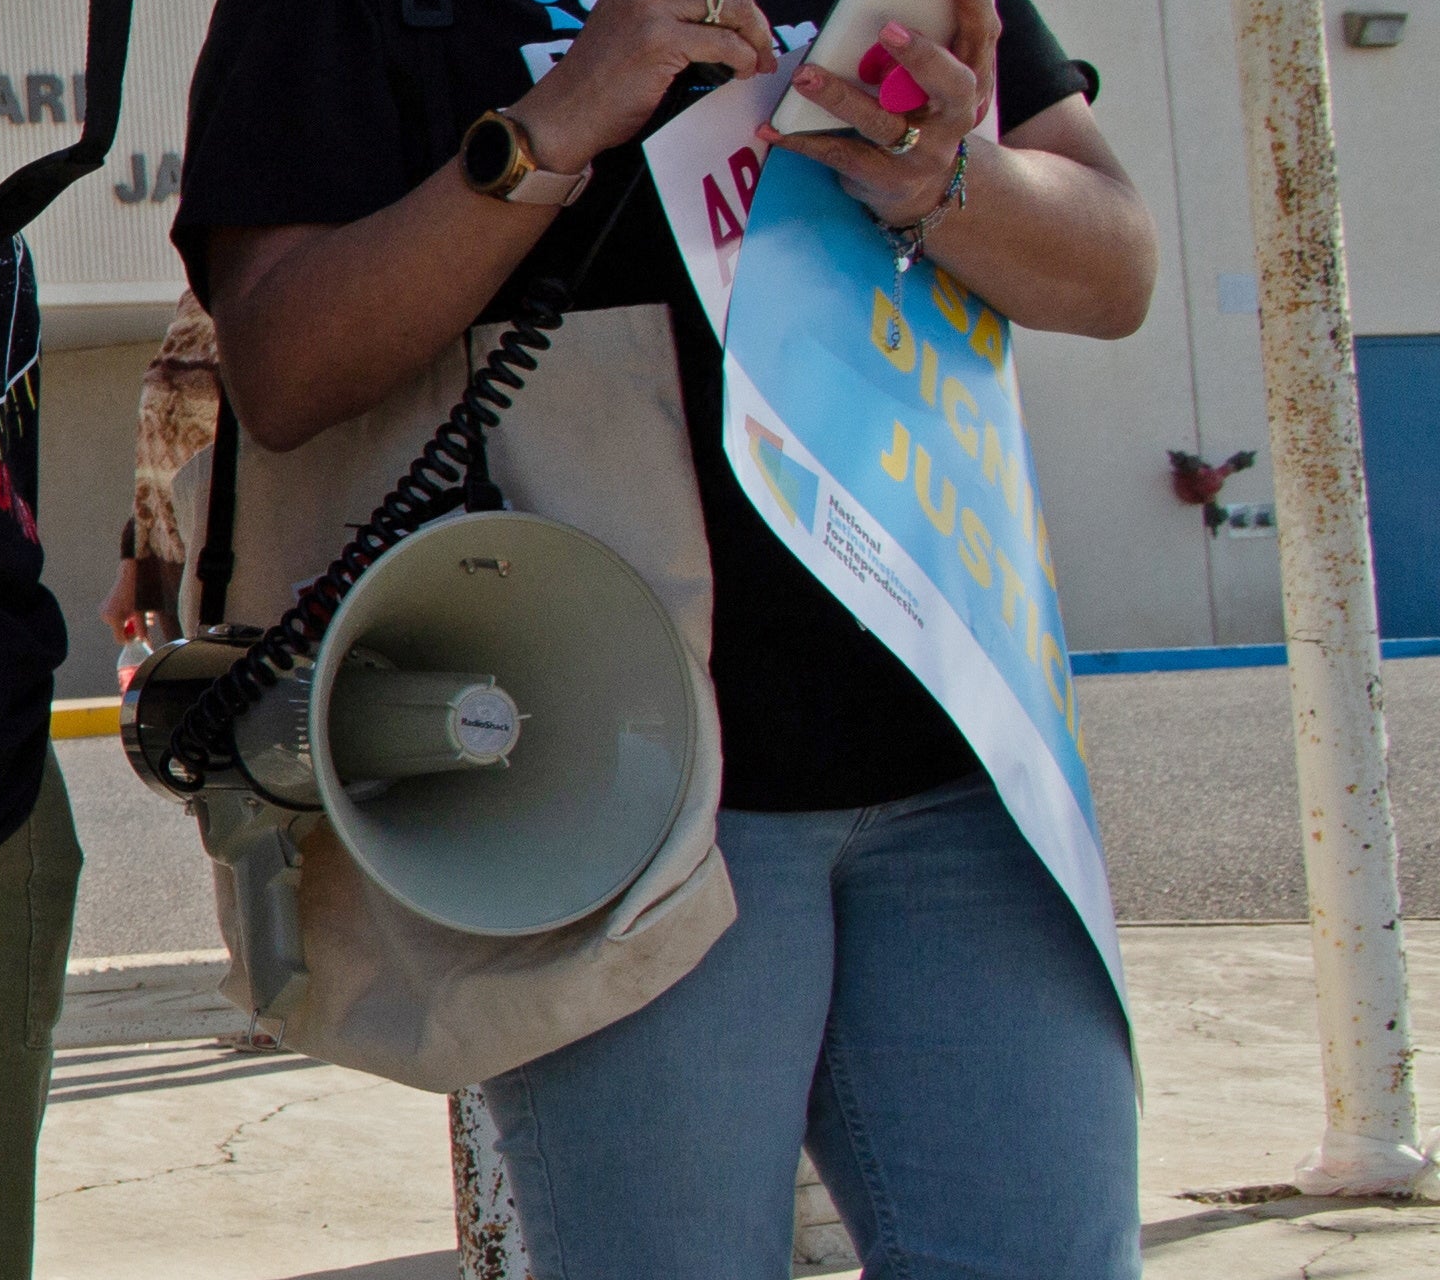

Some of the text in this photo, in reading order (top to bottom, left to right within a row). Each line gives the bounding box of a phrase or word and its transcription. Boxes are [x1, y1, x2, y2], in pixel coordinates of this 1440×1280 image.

[829, 494, 883, 556] National
[822, 534, 866, 585] Justice
[825, 521, 925, 630] for Reproductive
[880, 419, 1088, 762] JUSTICI
[461, 717, 510, 732] RadioShack
